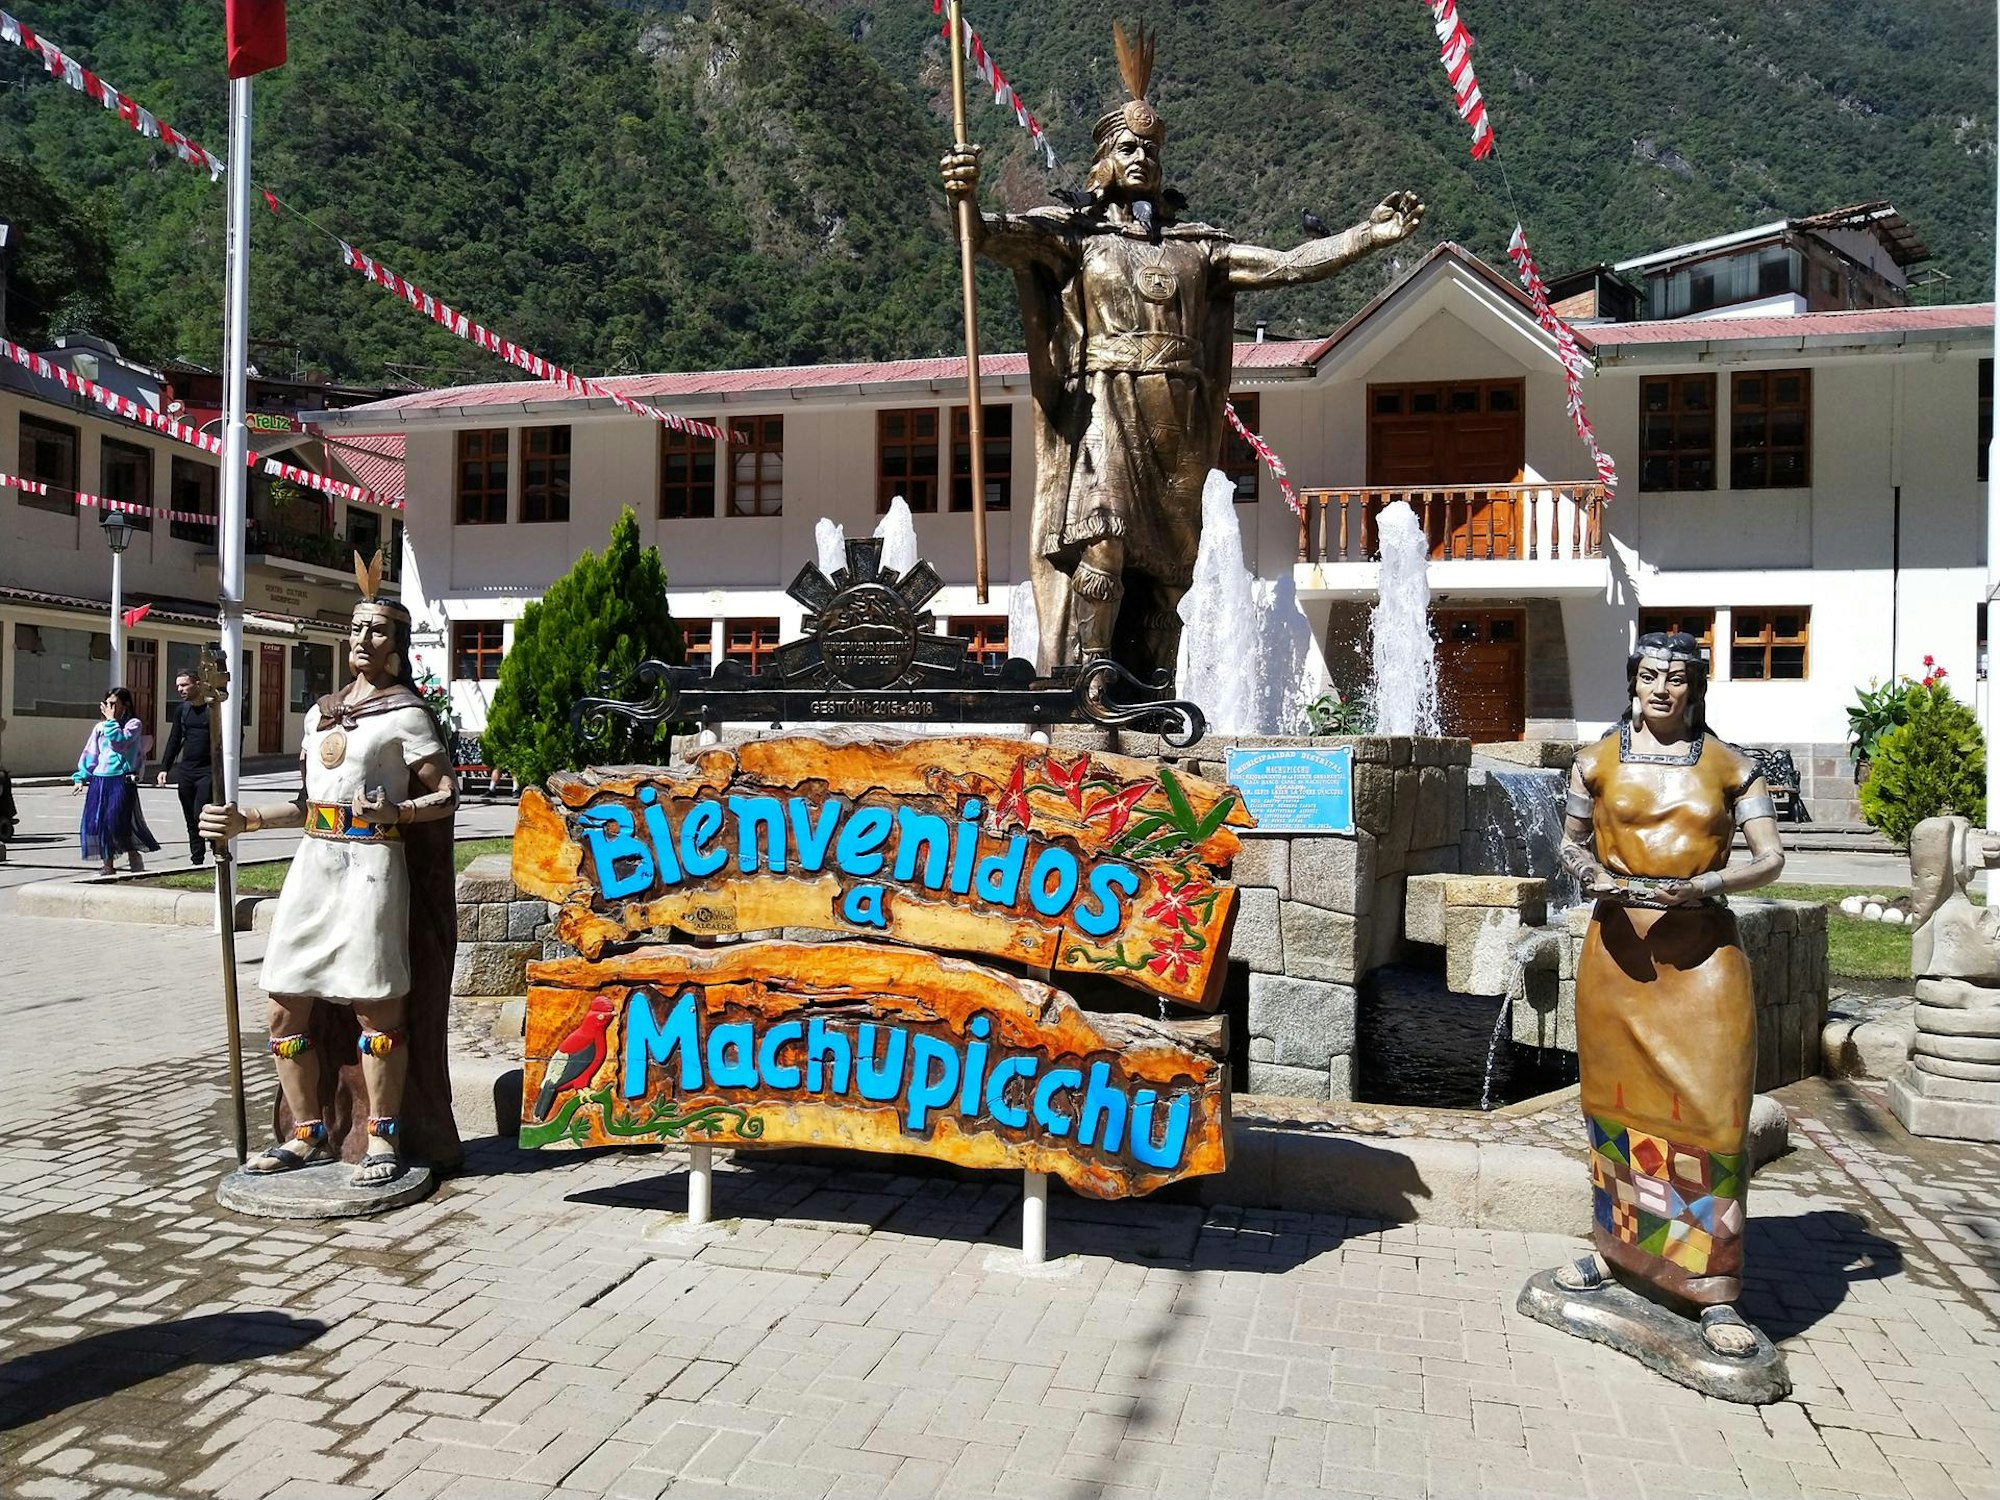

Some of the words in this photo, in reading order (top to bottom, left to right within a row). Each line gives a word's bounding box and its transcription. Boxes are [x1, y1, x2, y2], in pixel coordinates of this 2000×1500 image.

[579, 786, 1139, 936] Bienvenidos
[843, 885, 886, 929] a
[624, 993, 1192, 1170] Machupicchu
